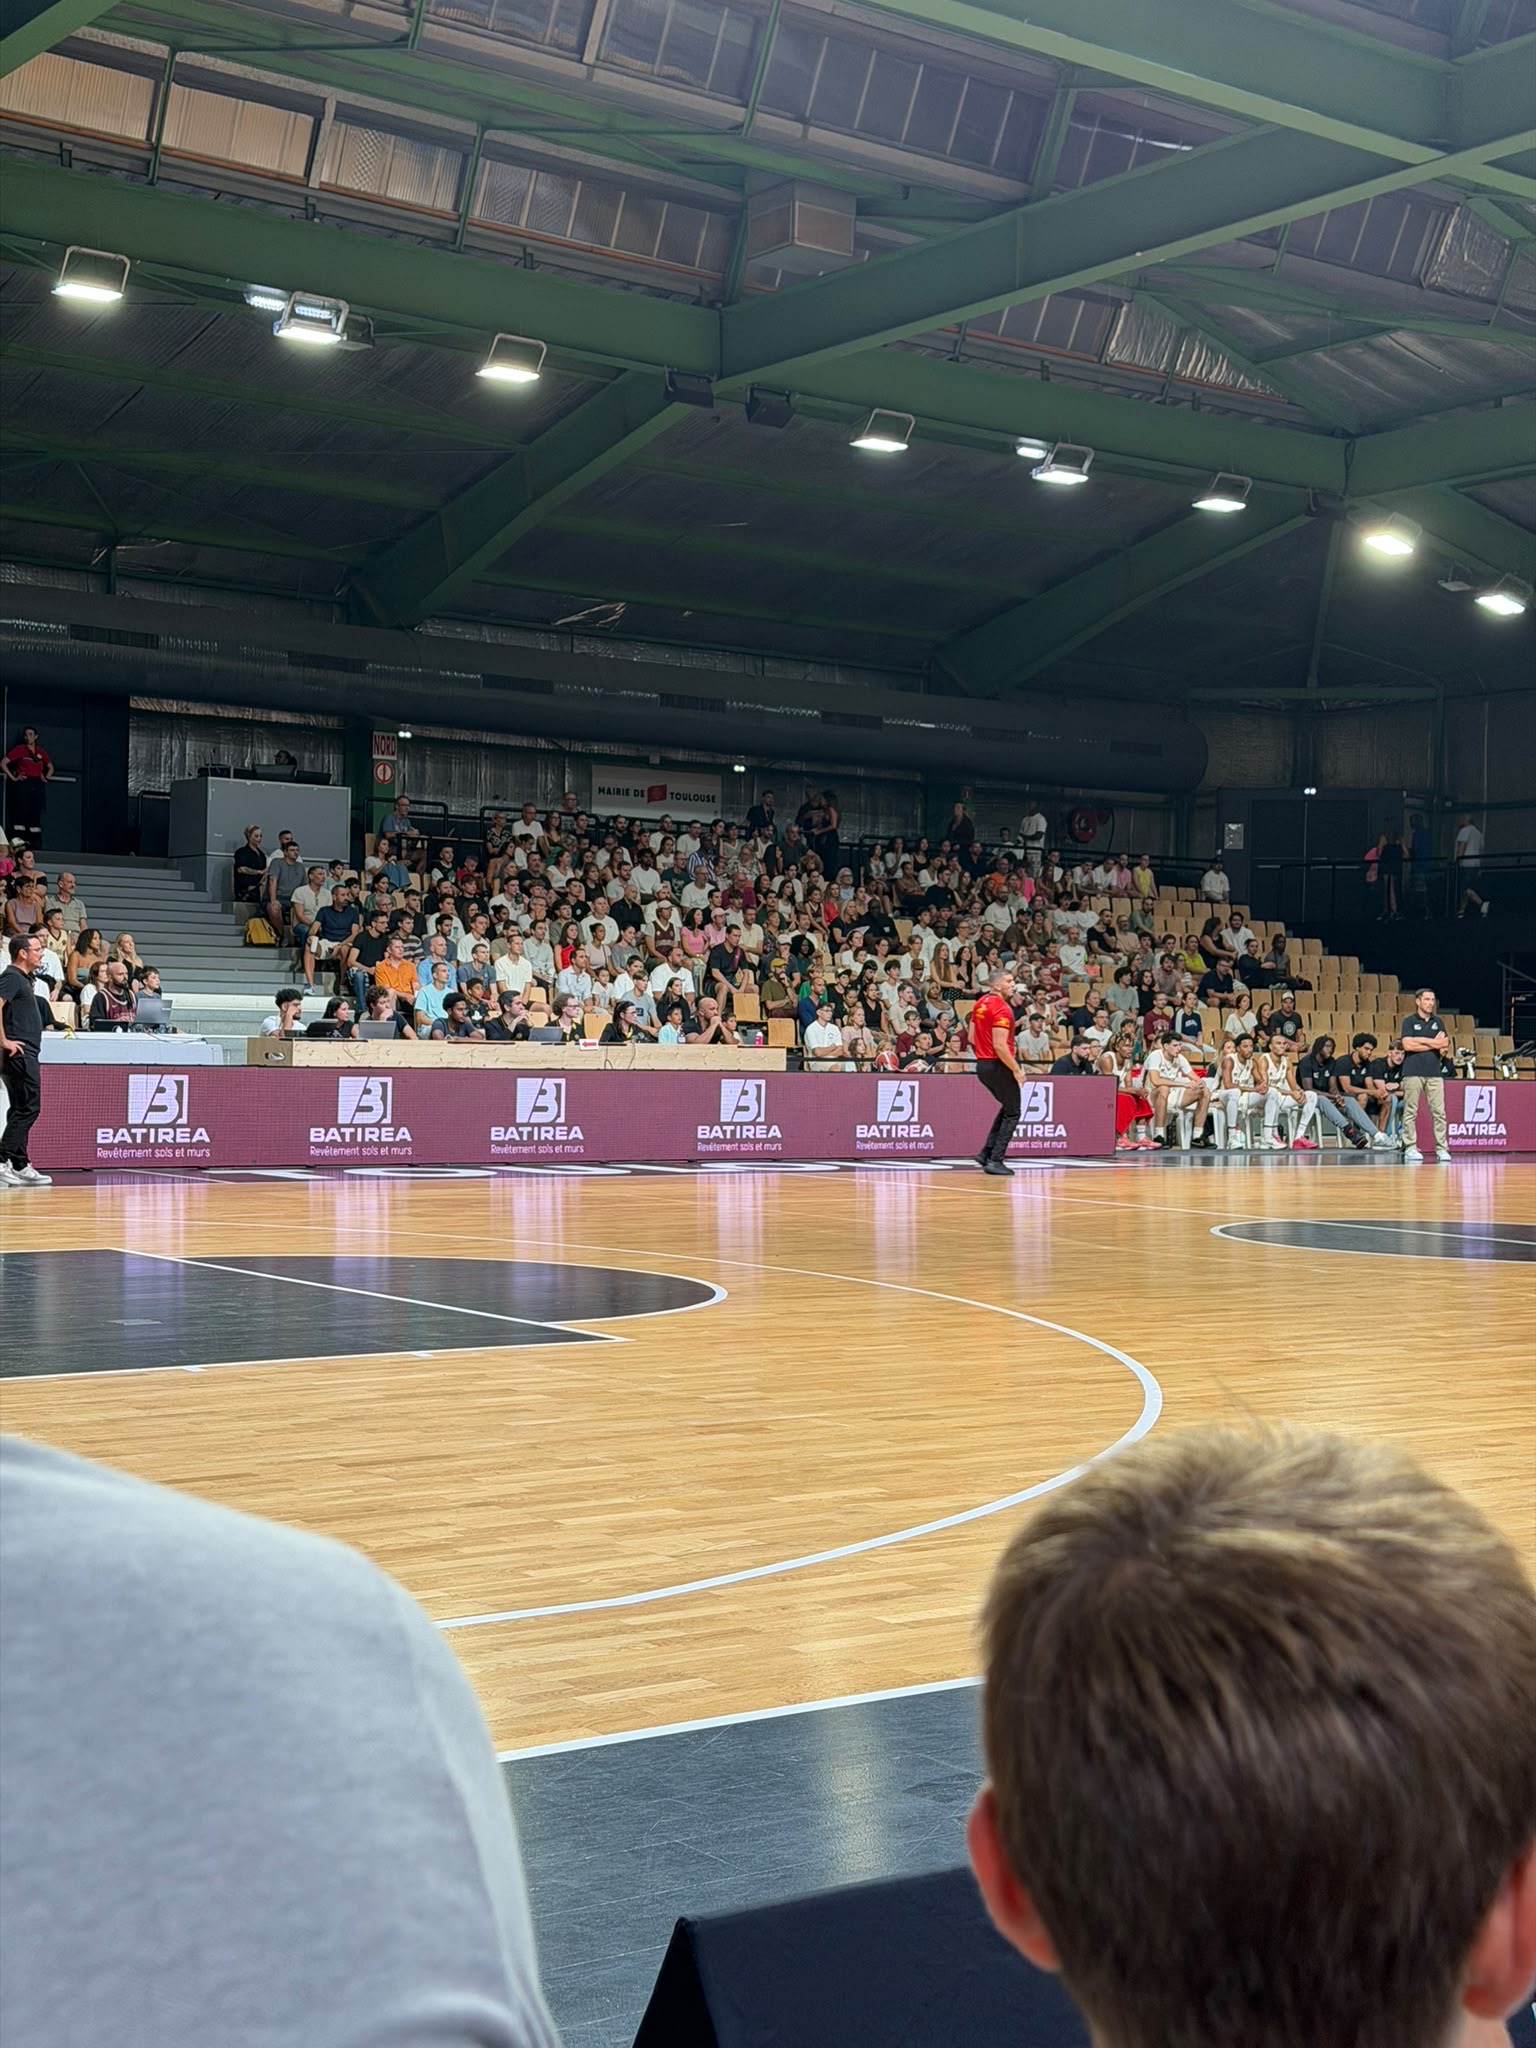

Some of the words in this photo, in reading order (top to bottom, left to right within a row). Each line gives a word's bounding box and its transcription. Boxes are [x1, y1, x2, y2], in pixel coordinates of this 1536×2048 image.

[374, 734, 396, 756] NORD
[598, 786, 630, 797] MAIRIE
[633, 788, 645, 798] DE
[670, 791, 716, 803] TOULOUSE
[97, 1128, 211, 1143] BATIREA
[310, 1127, 412, 1142] BATIREA
[491, 1126, 584, 1141] BATIREA
[697, 1125, 782, 1139] BATIREA
[856, 1124, 934, 1138] BATIREA
[1013, 1124, 1067, 1137] TIREA
[1448, 1124, 1506, 1136] BATIREA
[310, 1146, 360, 1156] Revêtement
[362, 1146, 379, 1156] sols
[380, 1146, 389, 1156] et
[391, 1146, 412, 1155] murs
[491, 1144, 536, 1154] Revêtement
[538, 1144, 553, 1154] sols
[555, 1144, 563, 1154] et
[564, 1144, 584, 1153] murs
[740, 1142, 754, 1151] sols
[755, 1142, 763, 1151] et
[764, 1142, 782, 1151] murs
[895, 1141, 908, 1150] sols
[909, 1141, 916, 1150] et
[917, 1141, 934, 1149] murs
[97, 1147, 152, 1158] Revêtement
[154, 1147, 174, 1158] sols
[175, 1147, 185, 1157] et
[187, 1148, 211, 1157] murs
